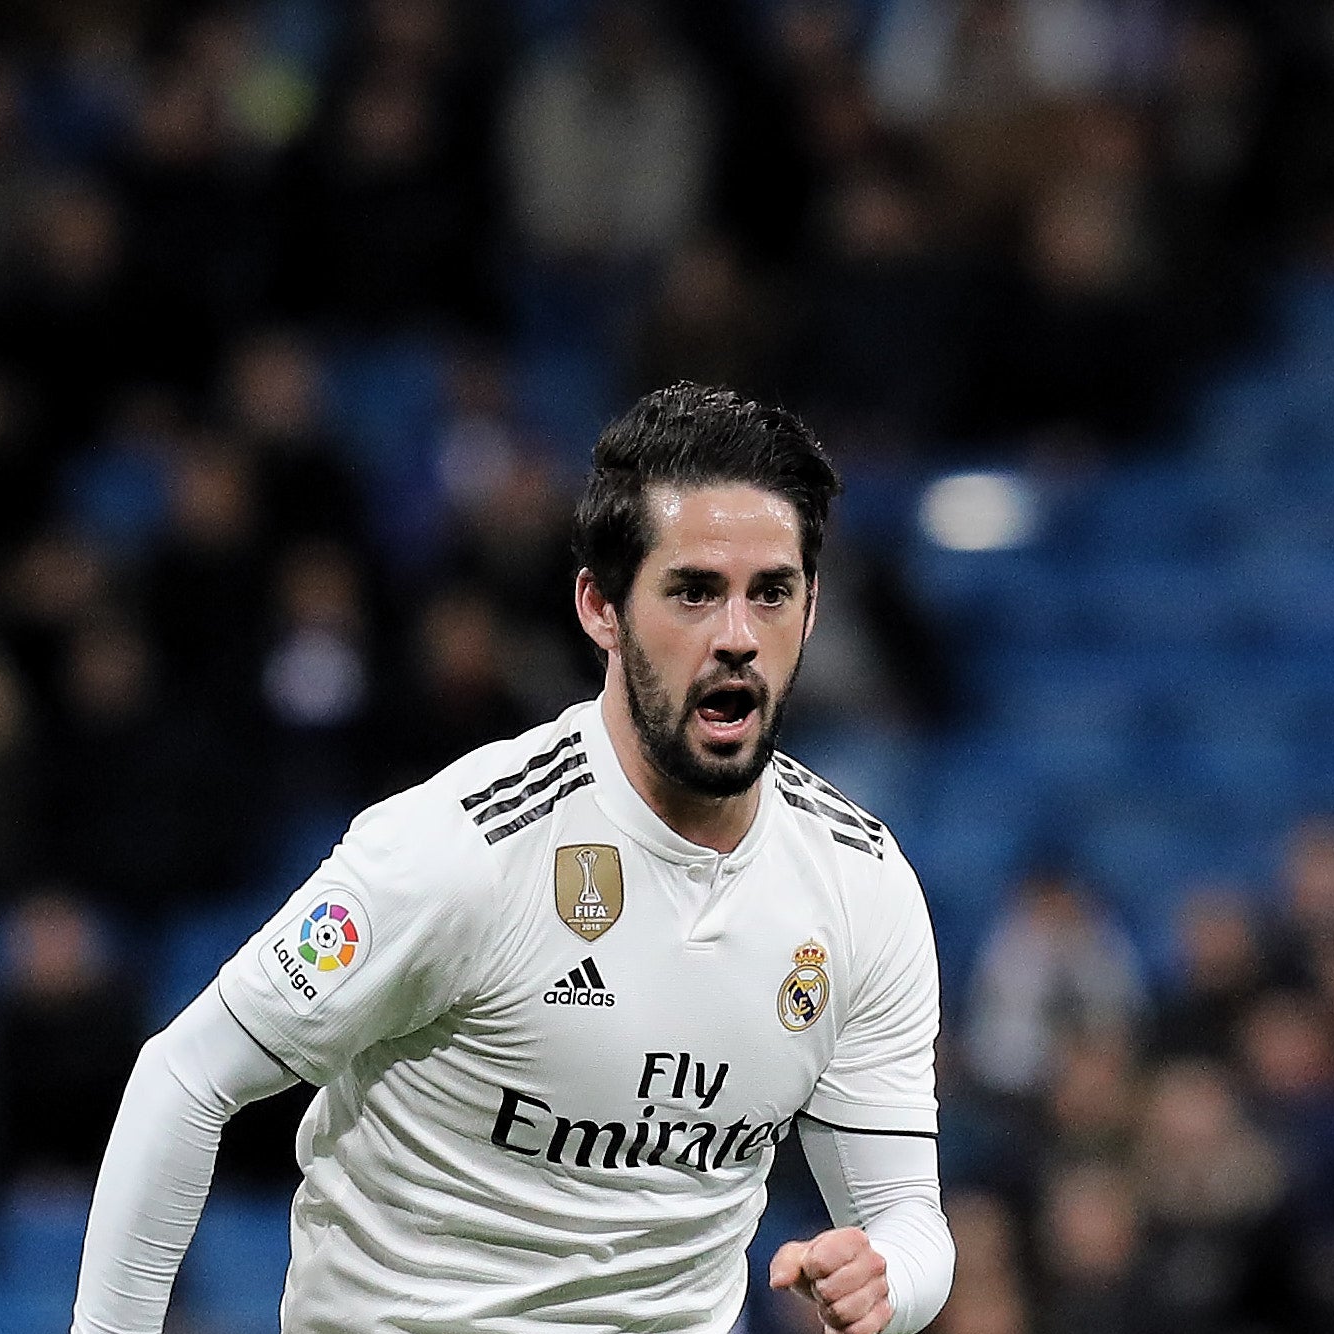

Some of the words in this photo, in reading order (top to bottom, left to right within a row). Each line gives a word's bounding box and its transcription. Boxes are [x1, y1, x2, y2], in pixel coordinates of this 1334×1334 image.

[574, 905, 606, 918] FIFA
[273, 938, 318, 1001] LaLiga
[543, 987, 616, 1007] adidas
[637, 1053, 729, 1109] Fly
